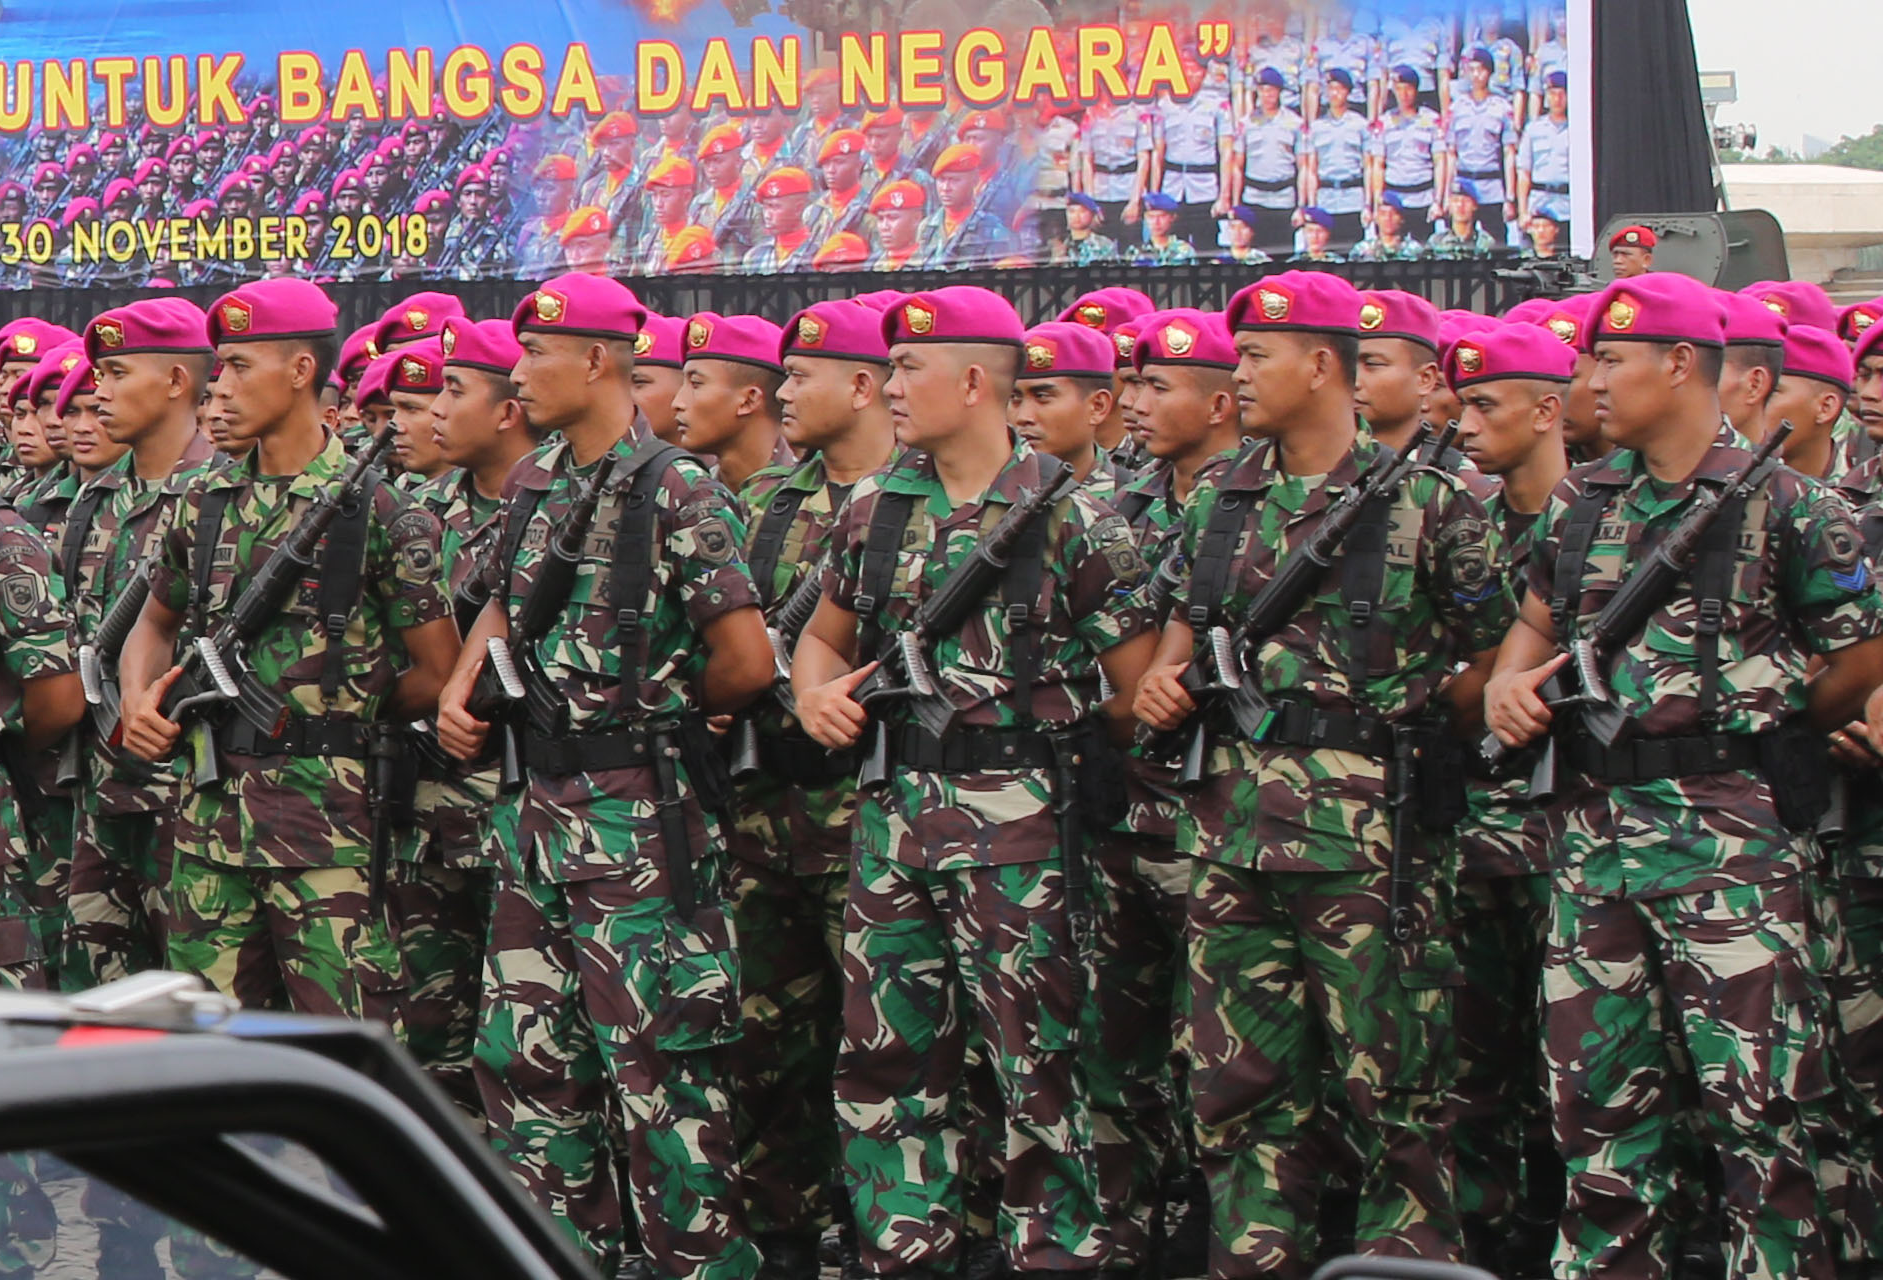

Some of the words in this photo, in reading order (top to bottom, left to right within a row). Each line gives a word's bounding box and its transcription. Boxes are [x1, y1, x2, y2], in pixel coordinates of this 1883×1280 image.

[278, 43, 604, 123] BANGSA
[636, 36, 800, 113] DAN
[0, 221, 54, 266] 30
[72, 214, 311, 264] NOVEMBER
[329, 212, 430, 260] 2018
